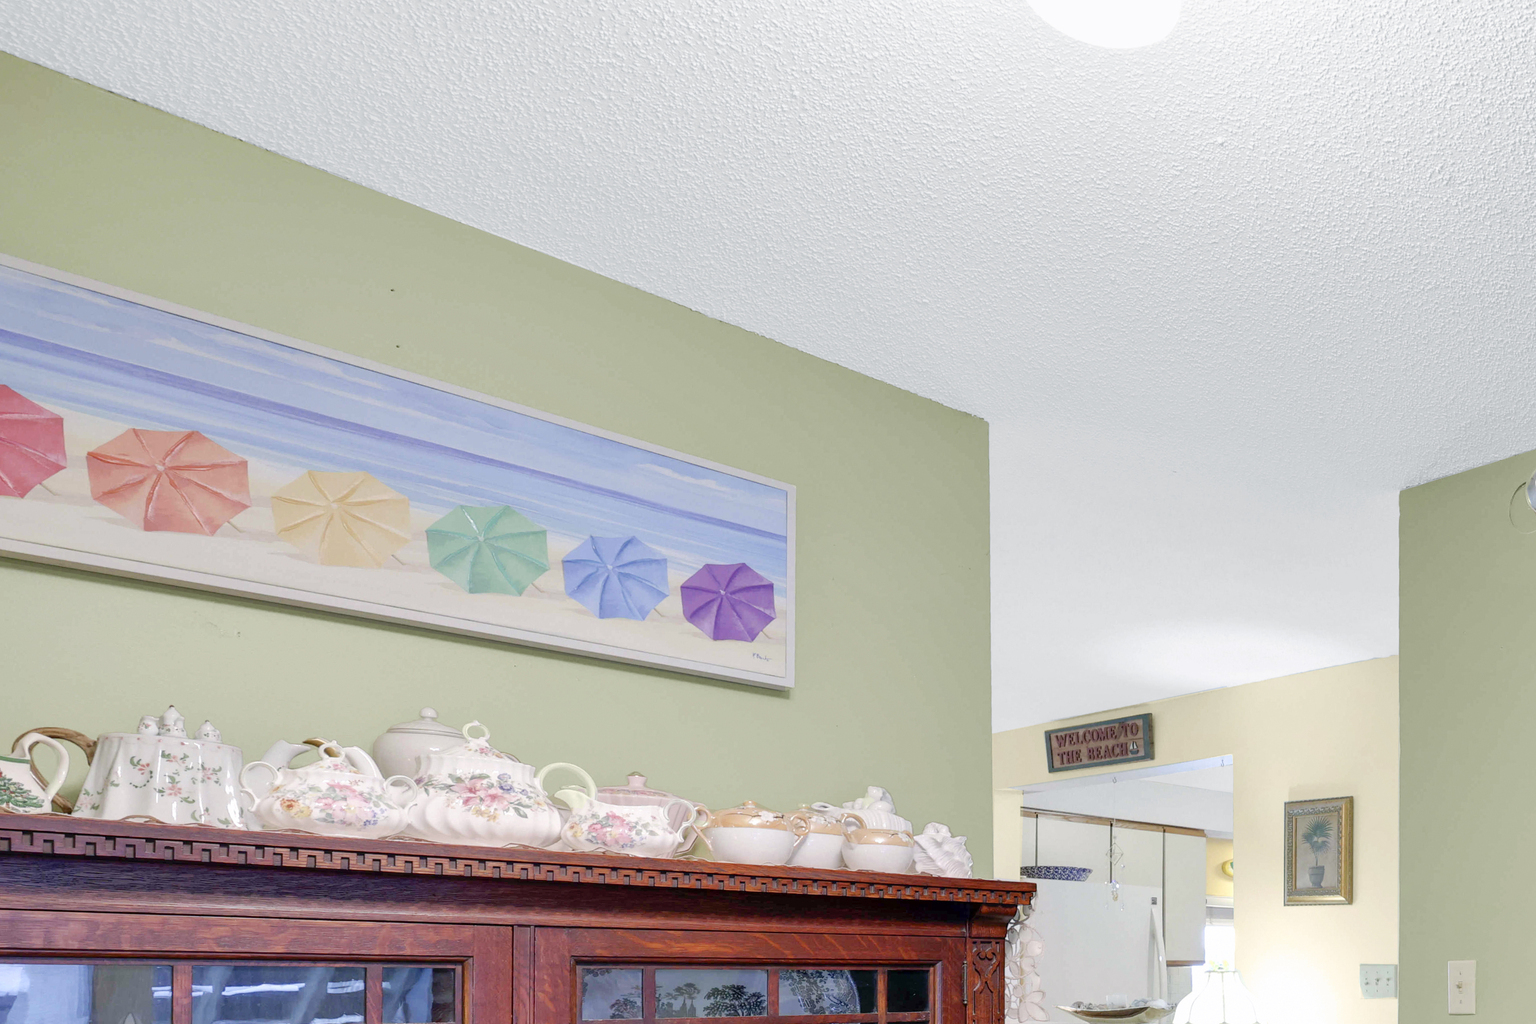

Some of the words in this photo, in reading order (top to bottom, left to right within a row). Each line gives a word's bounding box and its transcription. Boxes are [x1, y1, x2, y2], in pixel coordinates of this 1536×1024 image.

[1055, 725, 1118, 748] WELCOME
[1121, 722, 1139, 738] TO
[1057, 749, 1083, 766] THE
[1086, 742, 1129, 762] BEACH
